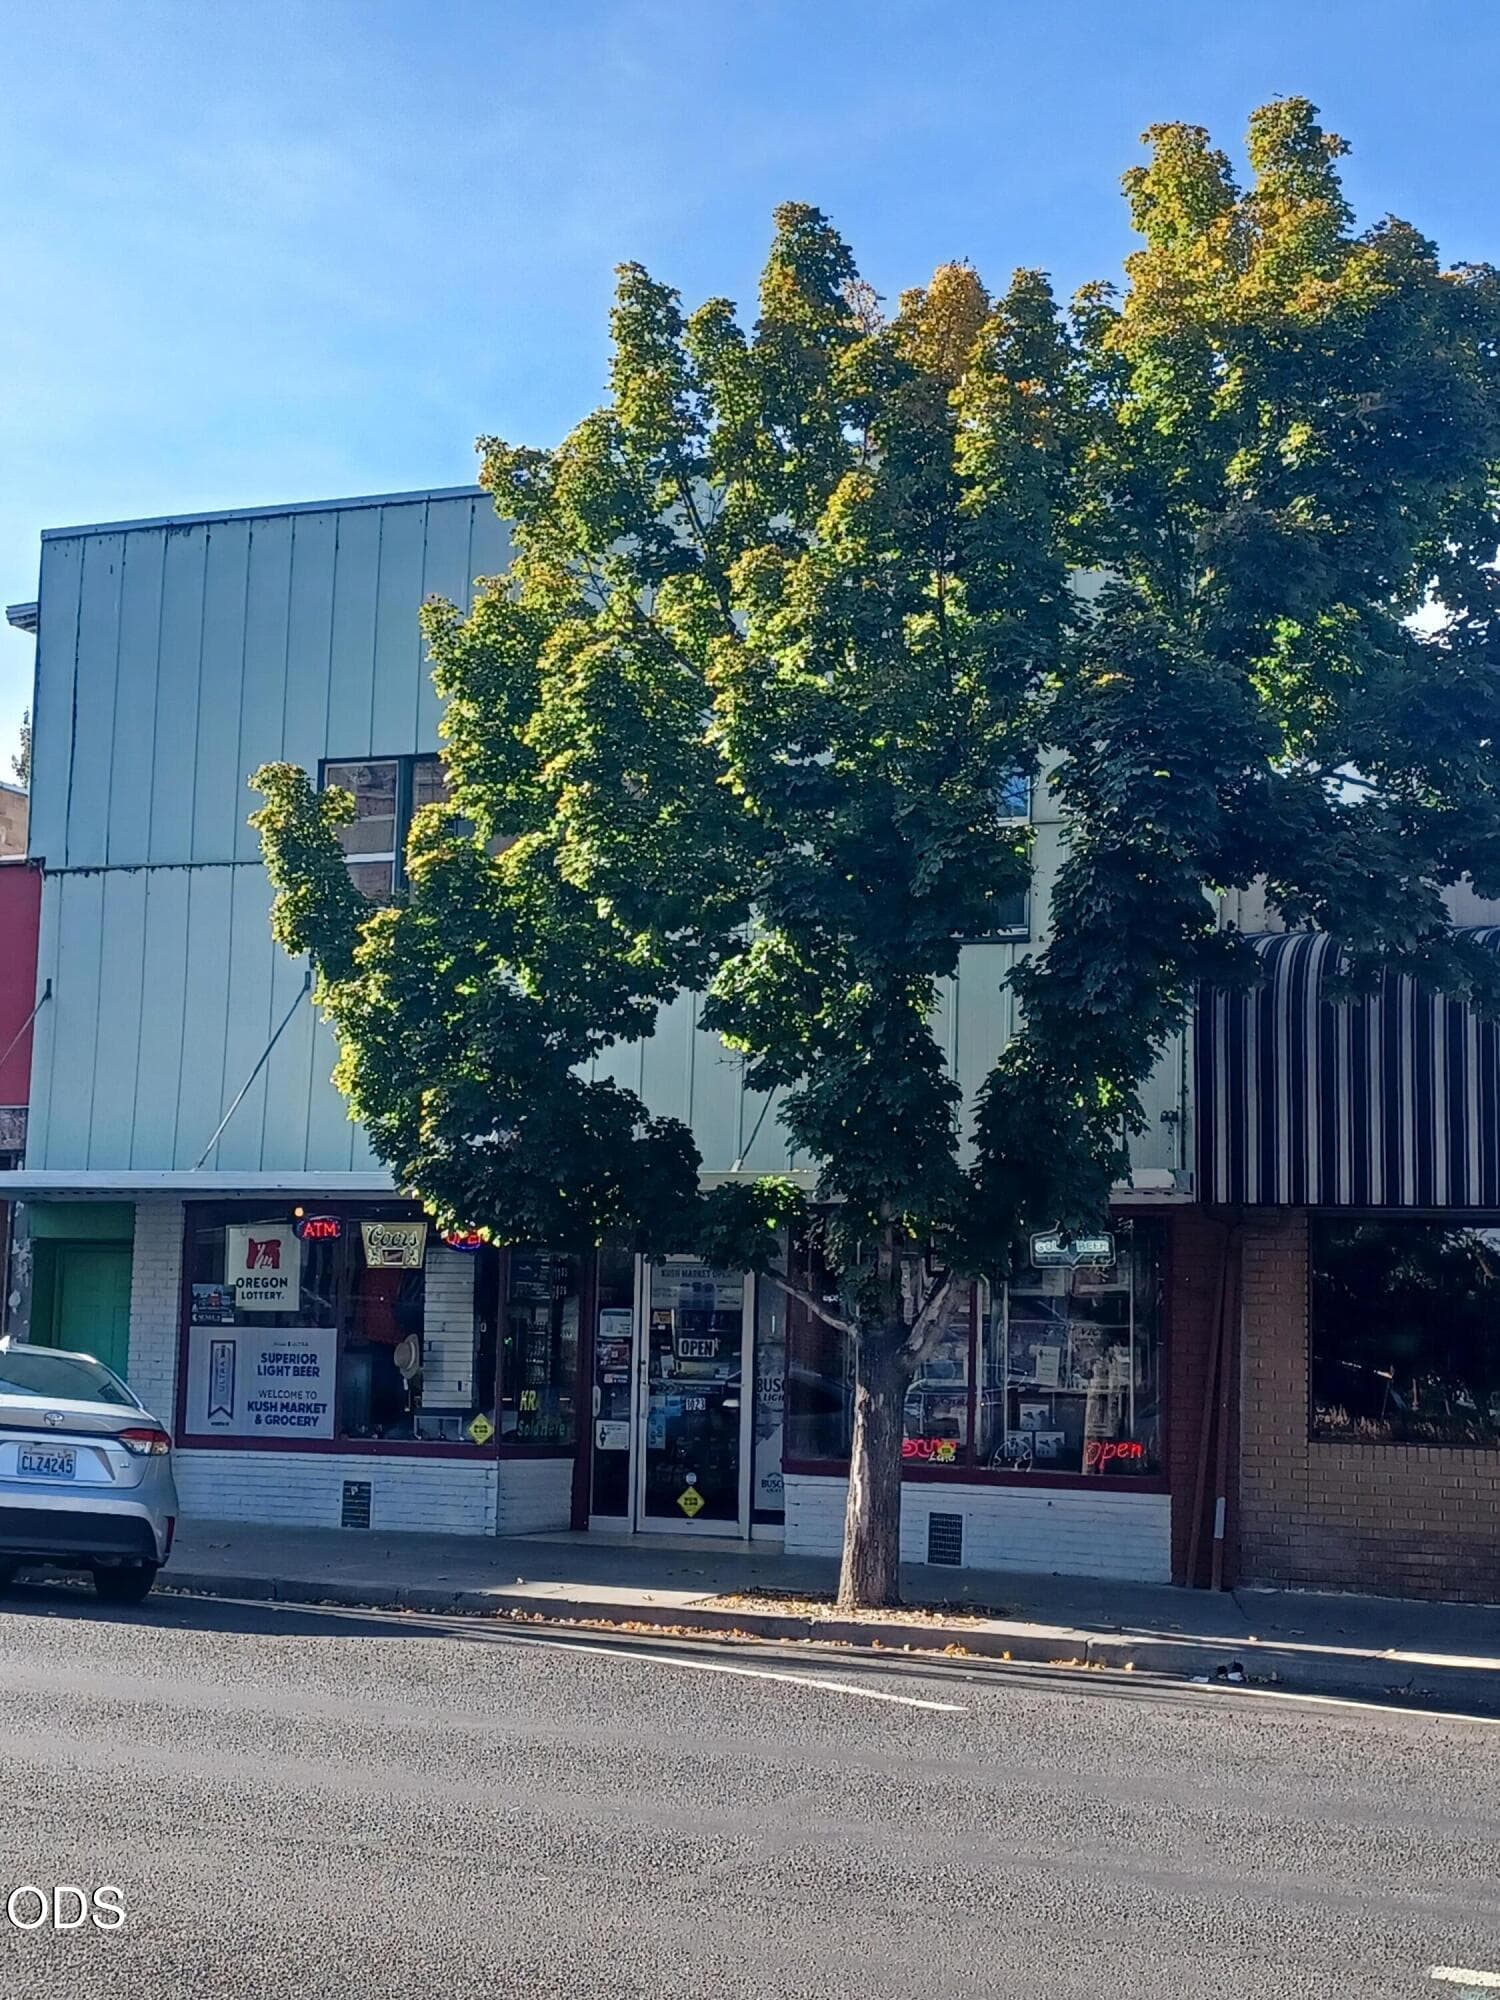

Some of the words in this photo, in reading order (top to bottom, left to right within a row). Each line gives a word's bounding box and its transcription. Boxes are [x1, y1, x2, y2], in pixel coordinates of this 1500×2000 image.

[303, 1222, 337, 1237] ATM
[367, 1224, 420, 1247] Coors
[1076, 1240, 1109, 1252] BEER
[235, 1277, 288, 1289] OREGON
[681, 1340, 713, 1356] OPEN
[260, 1352, 318, 1365] SUPERIOR
[257, 1365, 291, 1376] LIGHT
[292, 1366, 320, 1377] BEER
[258, 1390, 303, 1400] WELCOME
[305, 1391, 317, 1400] TO
[247, 1401, 278, 1412] KUSH
[279, 1402, 328, 1414] MARKET
[254, 1414, 262, 1425] &
[264, 1415, 319, 1427] GROCERY
[21, 1456, 73, 1473] CLZ4245
